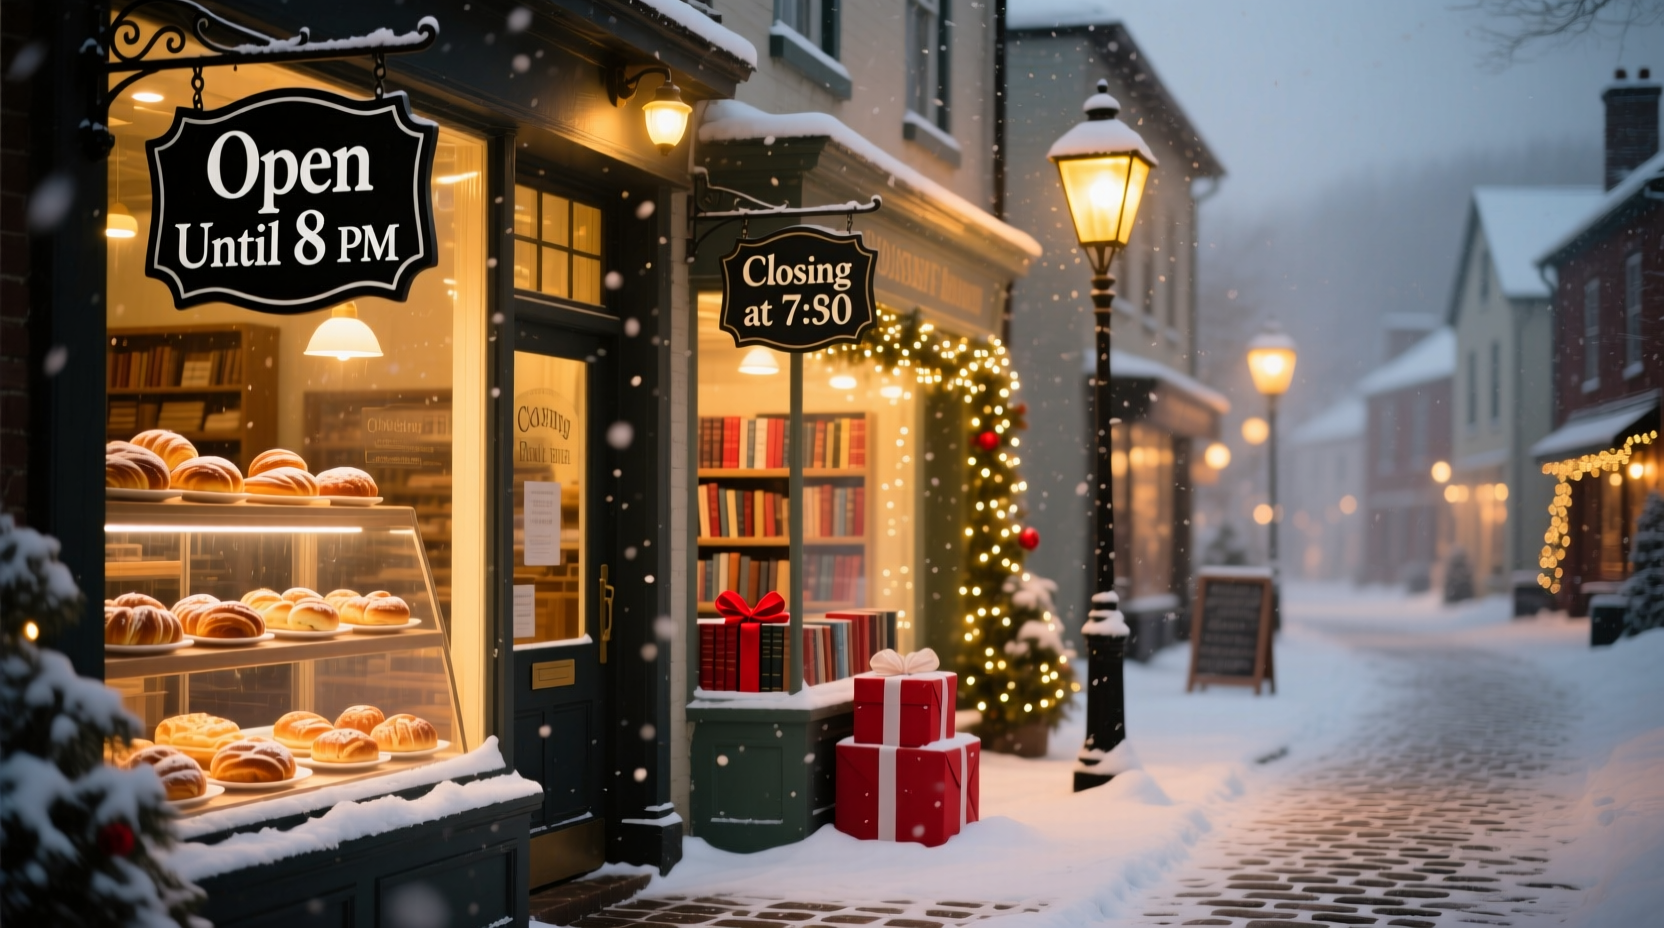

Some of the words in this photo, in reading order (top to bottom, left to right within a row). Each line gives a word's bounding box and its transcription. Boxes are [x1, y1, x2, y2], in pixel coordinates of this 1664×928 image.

[207, 130, 374, 214] Open
[174, 220, 282, 269] Until
[294, 209, 326, 266] 8
[337, 223, 400, 263] PM
[742, 253, 853, 291] Closing
[744, 301, 773, 327] at
